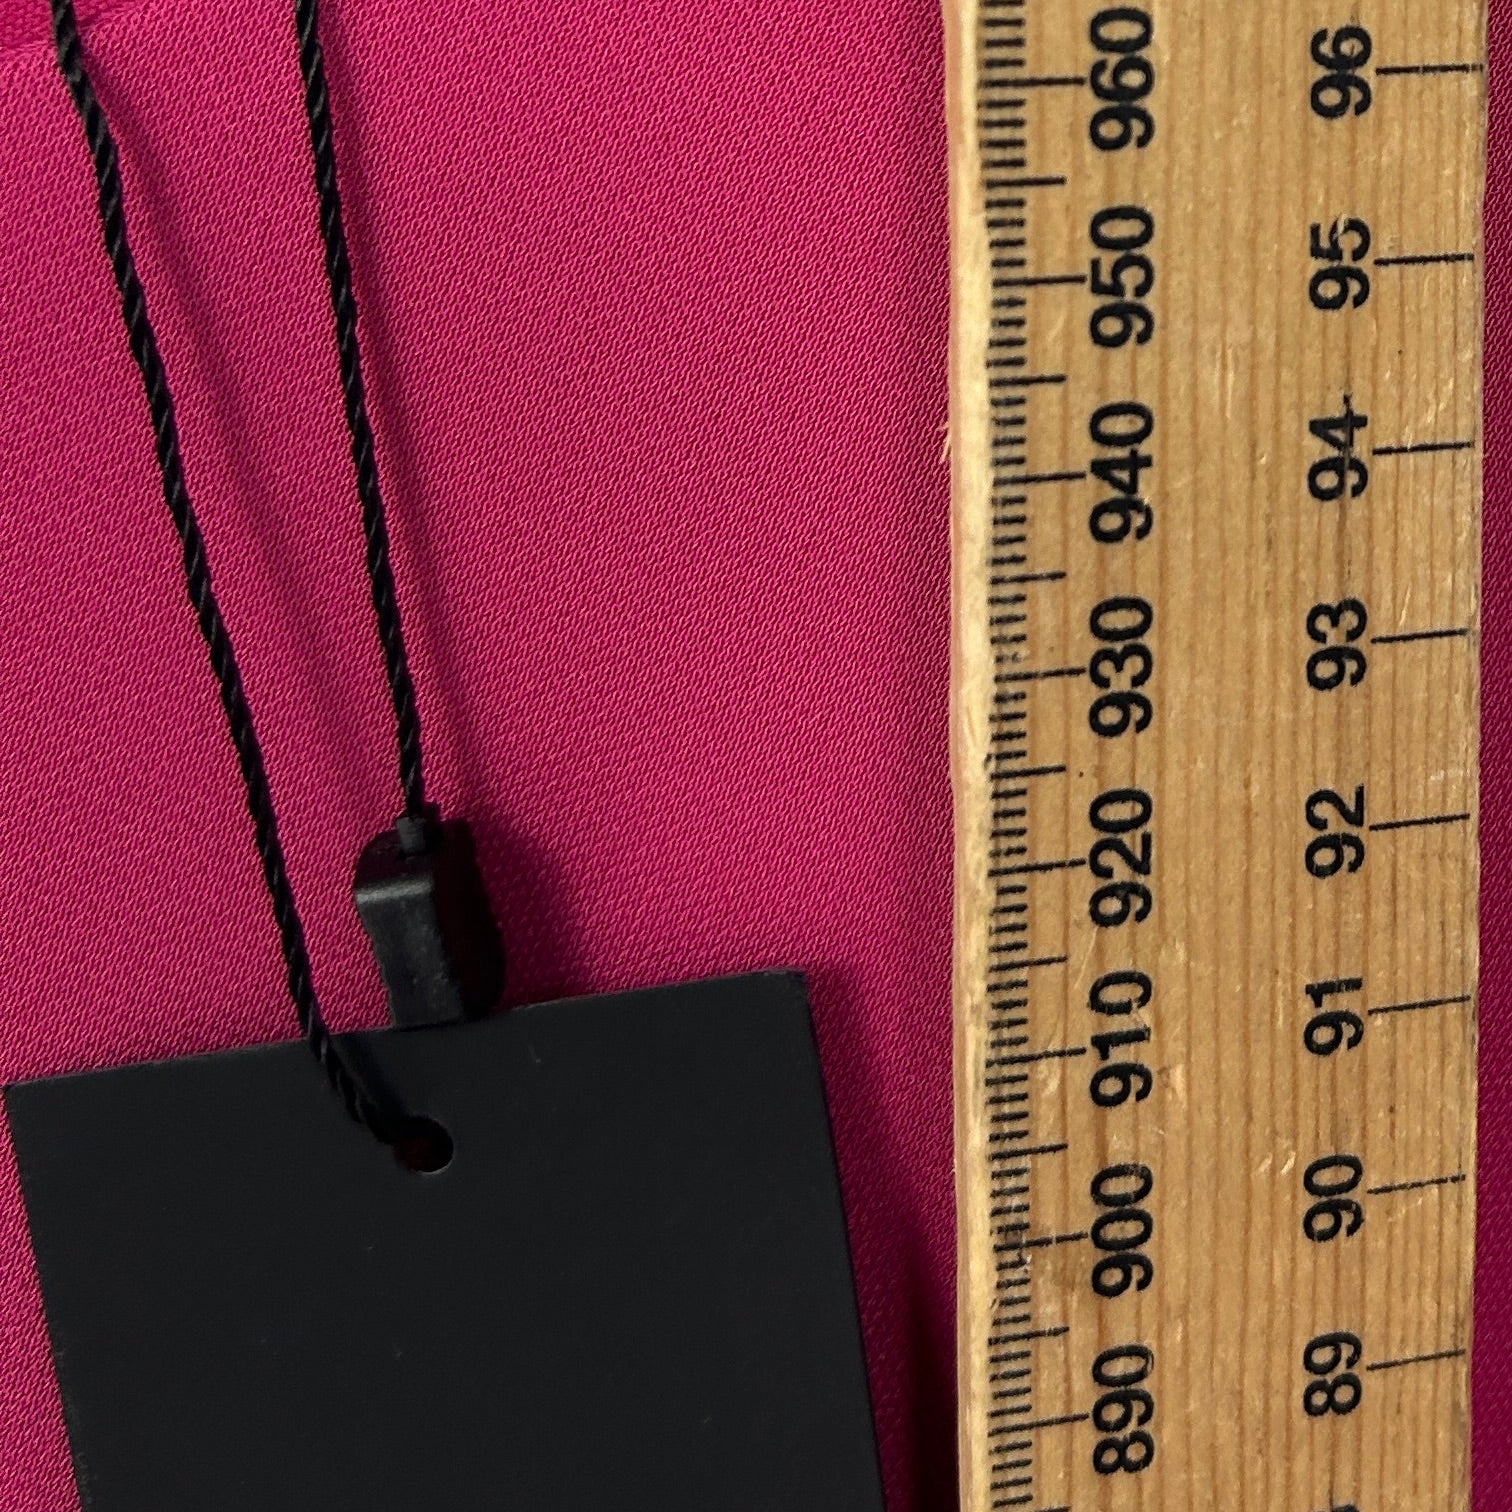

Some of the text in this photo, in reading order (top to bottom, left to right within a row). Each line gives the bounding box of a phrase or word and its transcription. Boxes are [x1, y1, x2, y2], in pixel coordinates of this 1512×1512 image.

[1089, 6, 1155, 152] 960
[1310, 25, 1372, 120] 96
[1089, 205, 1155, 349] 950
[1308, 217, 1371, 311] 95
[1089, 401, 1154, 544] 940
[1308, 412, 1369, 502] 94
[1089, 596, 1154, 738] 930
[1306, 598, 1368, 692] 93
[1089, 788, 1153, 929] 920
[1304, 785, 1365, 879] 92
[1089, 970, 1153, 1109] 910
[1303, 977, 1364, 1057] 91
[1090, 1163, 1154, 1299] 900
[1302, 1154, 1364, 1243] 90
[1091, 1344, 1155, 1476] 890
[1303, 1331, 1363, 1418] 89
